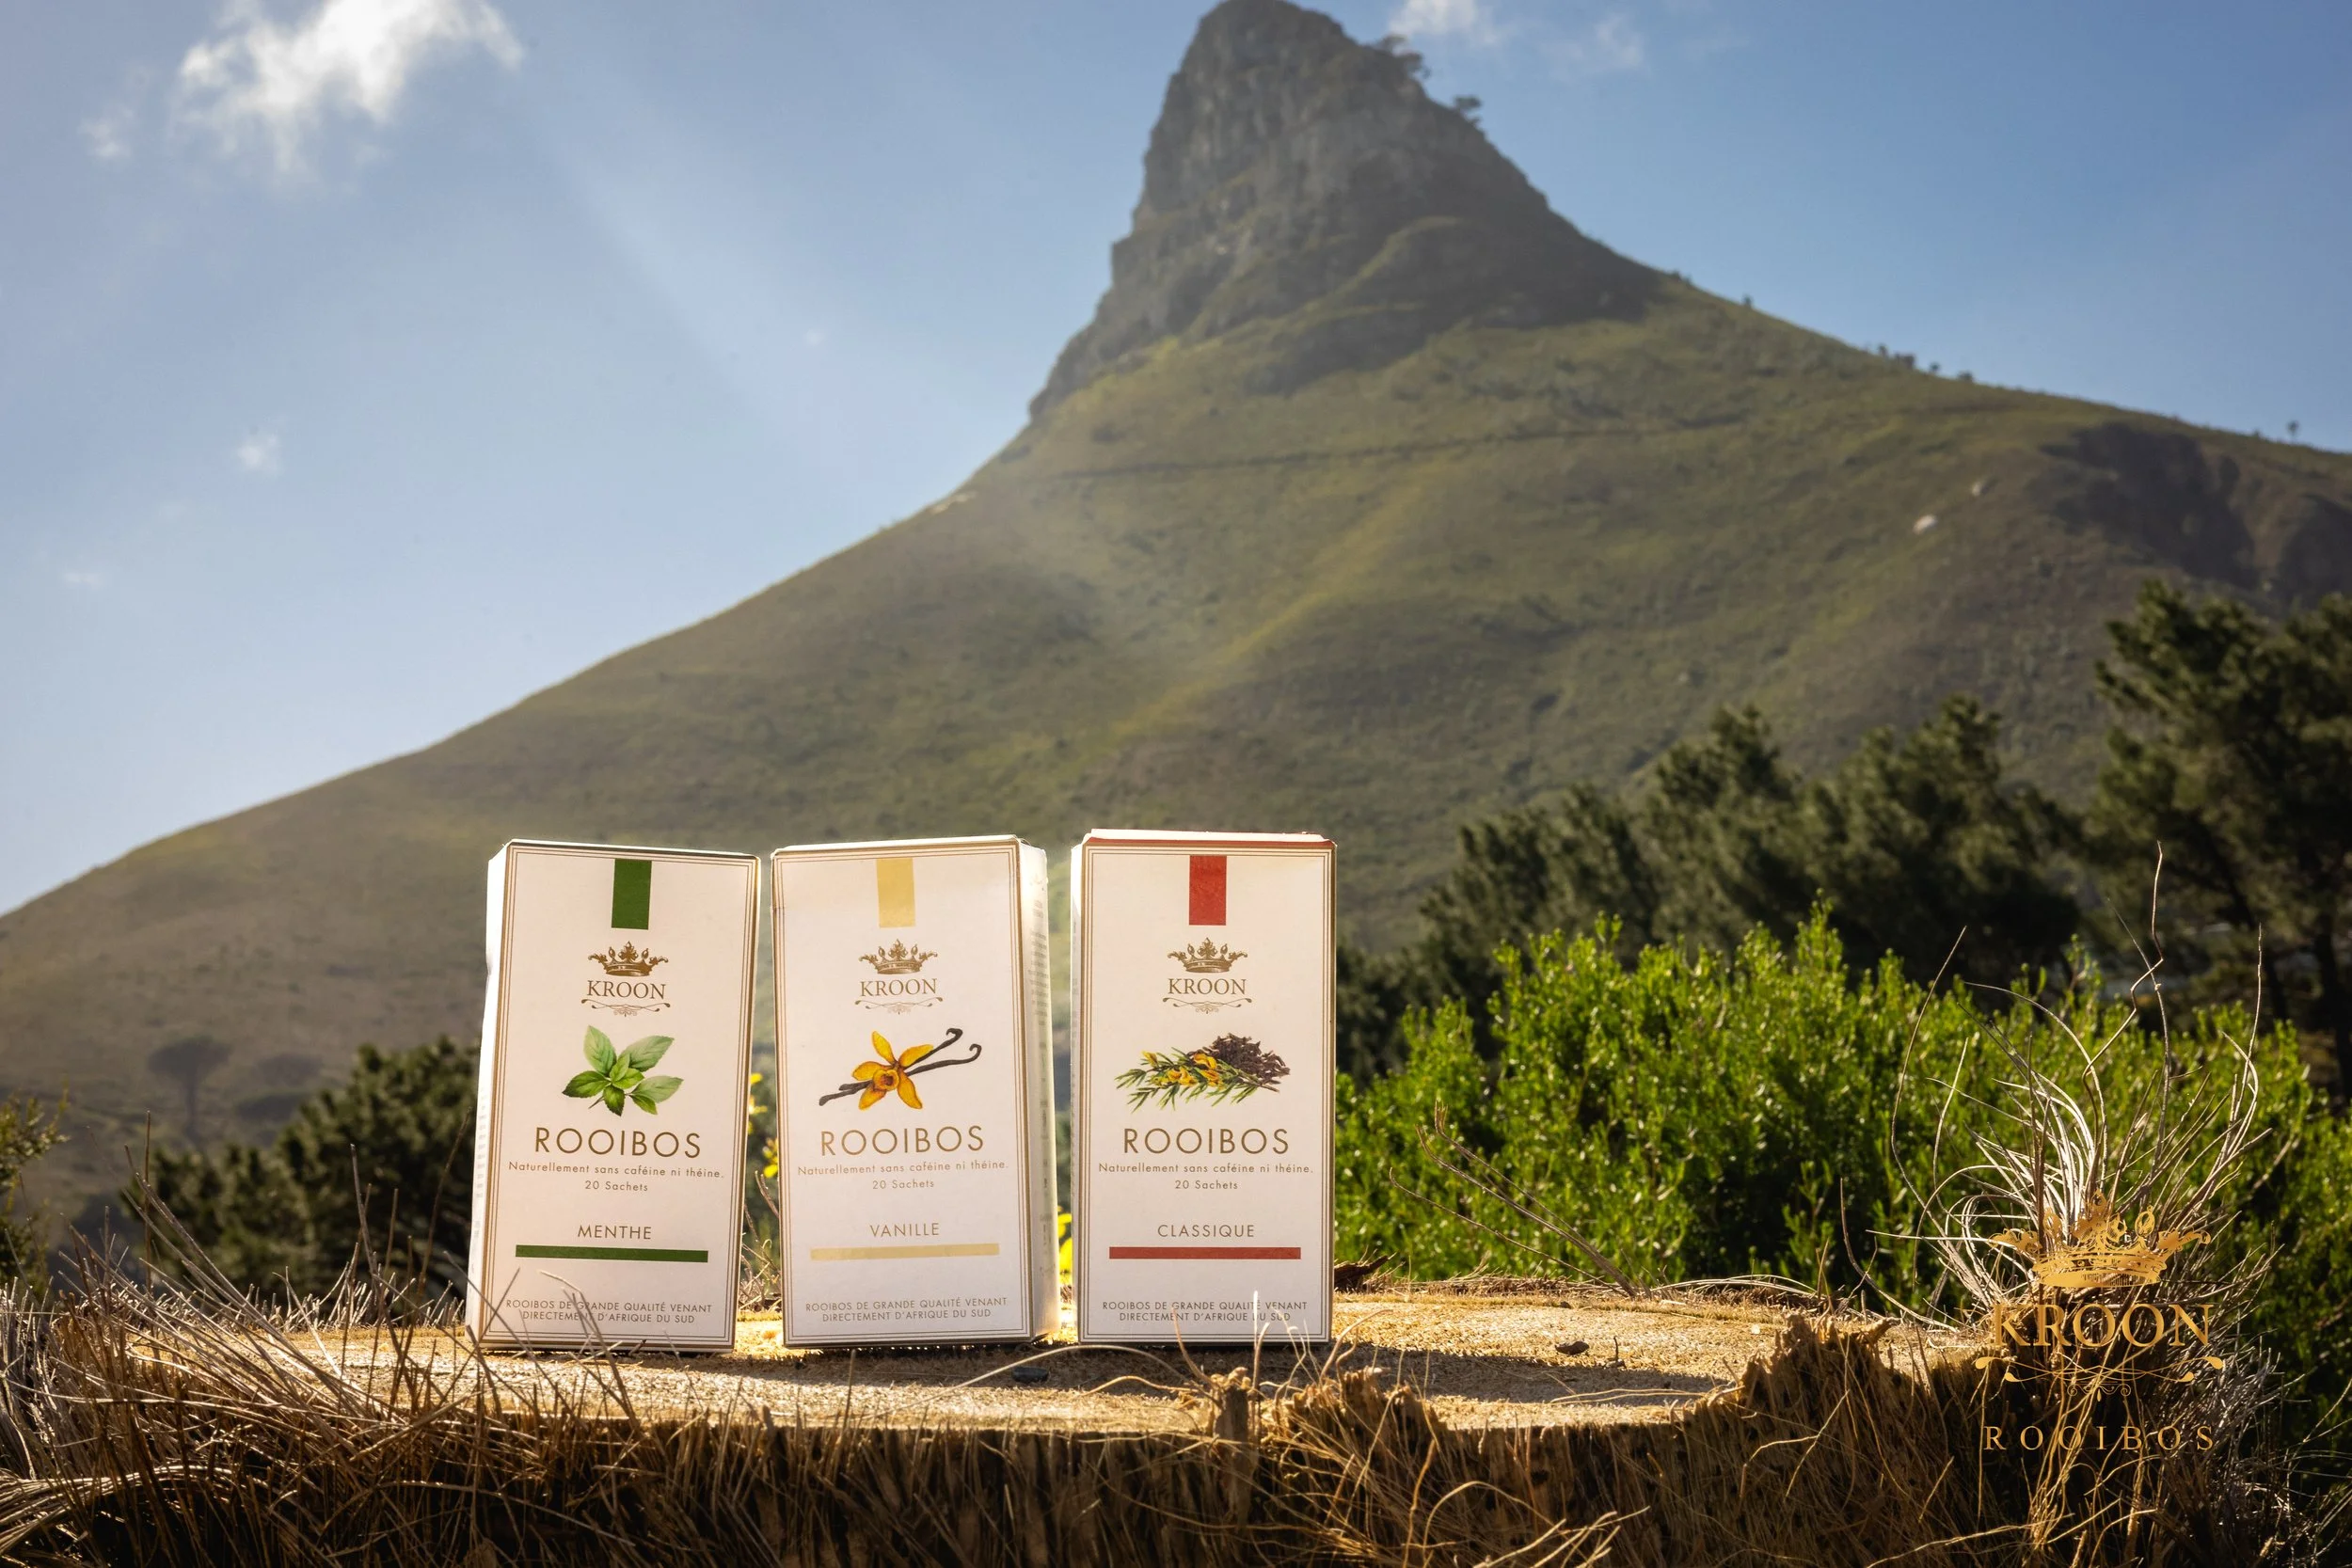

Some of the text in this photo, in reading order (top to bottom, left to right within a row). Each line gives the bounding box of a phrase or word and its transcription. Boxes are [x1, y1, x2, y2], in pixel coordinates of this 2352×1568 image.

[587, 980, 666, 999] KROON
[860, 978, 937, 997] KROON
[1168, 978, 1247, 995] KROON
[535, 1127, 701, 1158] ROOIBOS
[821, 1125, 983, 1156] ROOIBOS
[1123, 1128, 1289, 1154] ROOIBOS
[508, 1161, 724, 1179] Naturellement sans caféine ni théine.
[797, 1159, 1009, 1176] Naturellement sans caféine ni théine.
[1098, 1162, 1314, 1174] Naturellement sans caféine ni théine.
[584, 1180, 649, 1193] 20 Sachets
[871, 1178, 935, 1190] 20 Sachets
[1174, 1180, 1239, 1191] 20 Sachets
[578, 1226, 651, 1239] MENTHE
[870, 1223, 940, 1237] VANILLE
[1158, 1225, 1254, 1237] CLASSIQUE
[505, 1299, 555, 1310] ROOIBOS
[558, 1300, 573, 1310] DE
[624, 1300, 667, 1312] QUALITÉ
[669, 1302, 712, 1314] VENANT
[805, 1296, 1008, 1312] ROOIBOS DE GRANDE QUALITÉ VENANT
[1102, 1300, 1152, 1310] ROOIBOS
[1153, 1300, 1168, 1310] DE
[1171, 1300, 1216, 1310] GRANDE
[656, 1313, 671, 1323] DU
[674, 1313, 695, 1324] SUD
[821, 1311, 892, 1323] DIRECTEMENT
[953, 1307, 968, 1319] DU
[971, 1307, 992, 1318] SUD
